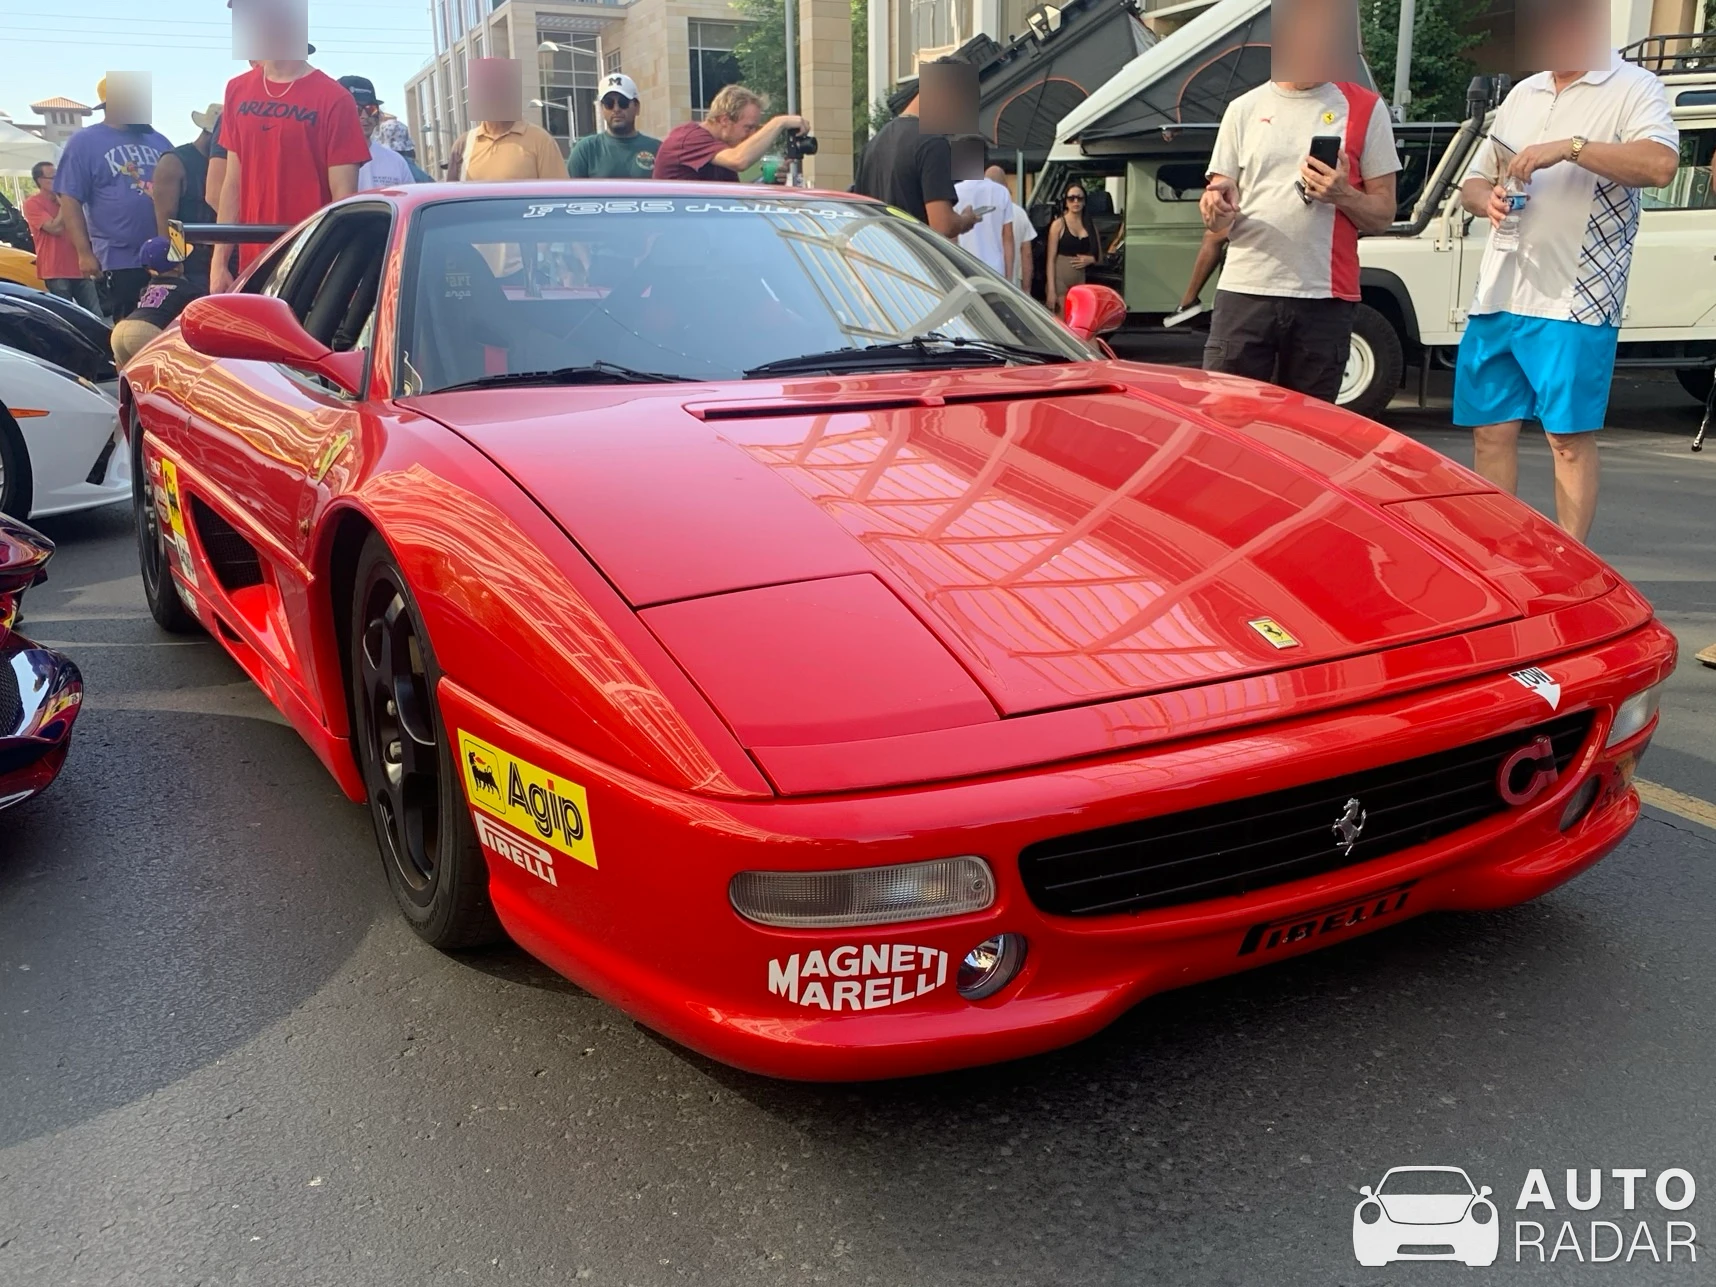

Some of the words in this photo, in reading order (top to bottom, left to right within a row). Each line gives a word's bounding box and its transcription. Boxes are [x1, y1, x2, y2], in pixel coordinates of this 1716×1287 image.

[608, 77, 622, 86] M
[238, 101, 318, 127] ARIZONA
[523, 201, 675, 218] F355
[685, 203, 859, 219] challenge
[1511, 668, 1552, 687] TOW
[508, 762, 584, 847] Agip
[474, 811, 558, 887] PIRELLI
[1237, 878, 1421, 956] PIRELLI
[768, 944, 948, 986] MAGNETI
[768, 964, 948, 1011] MARELLI
